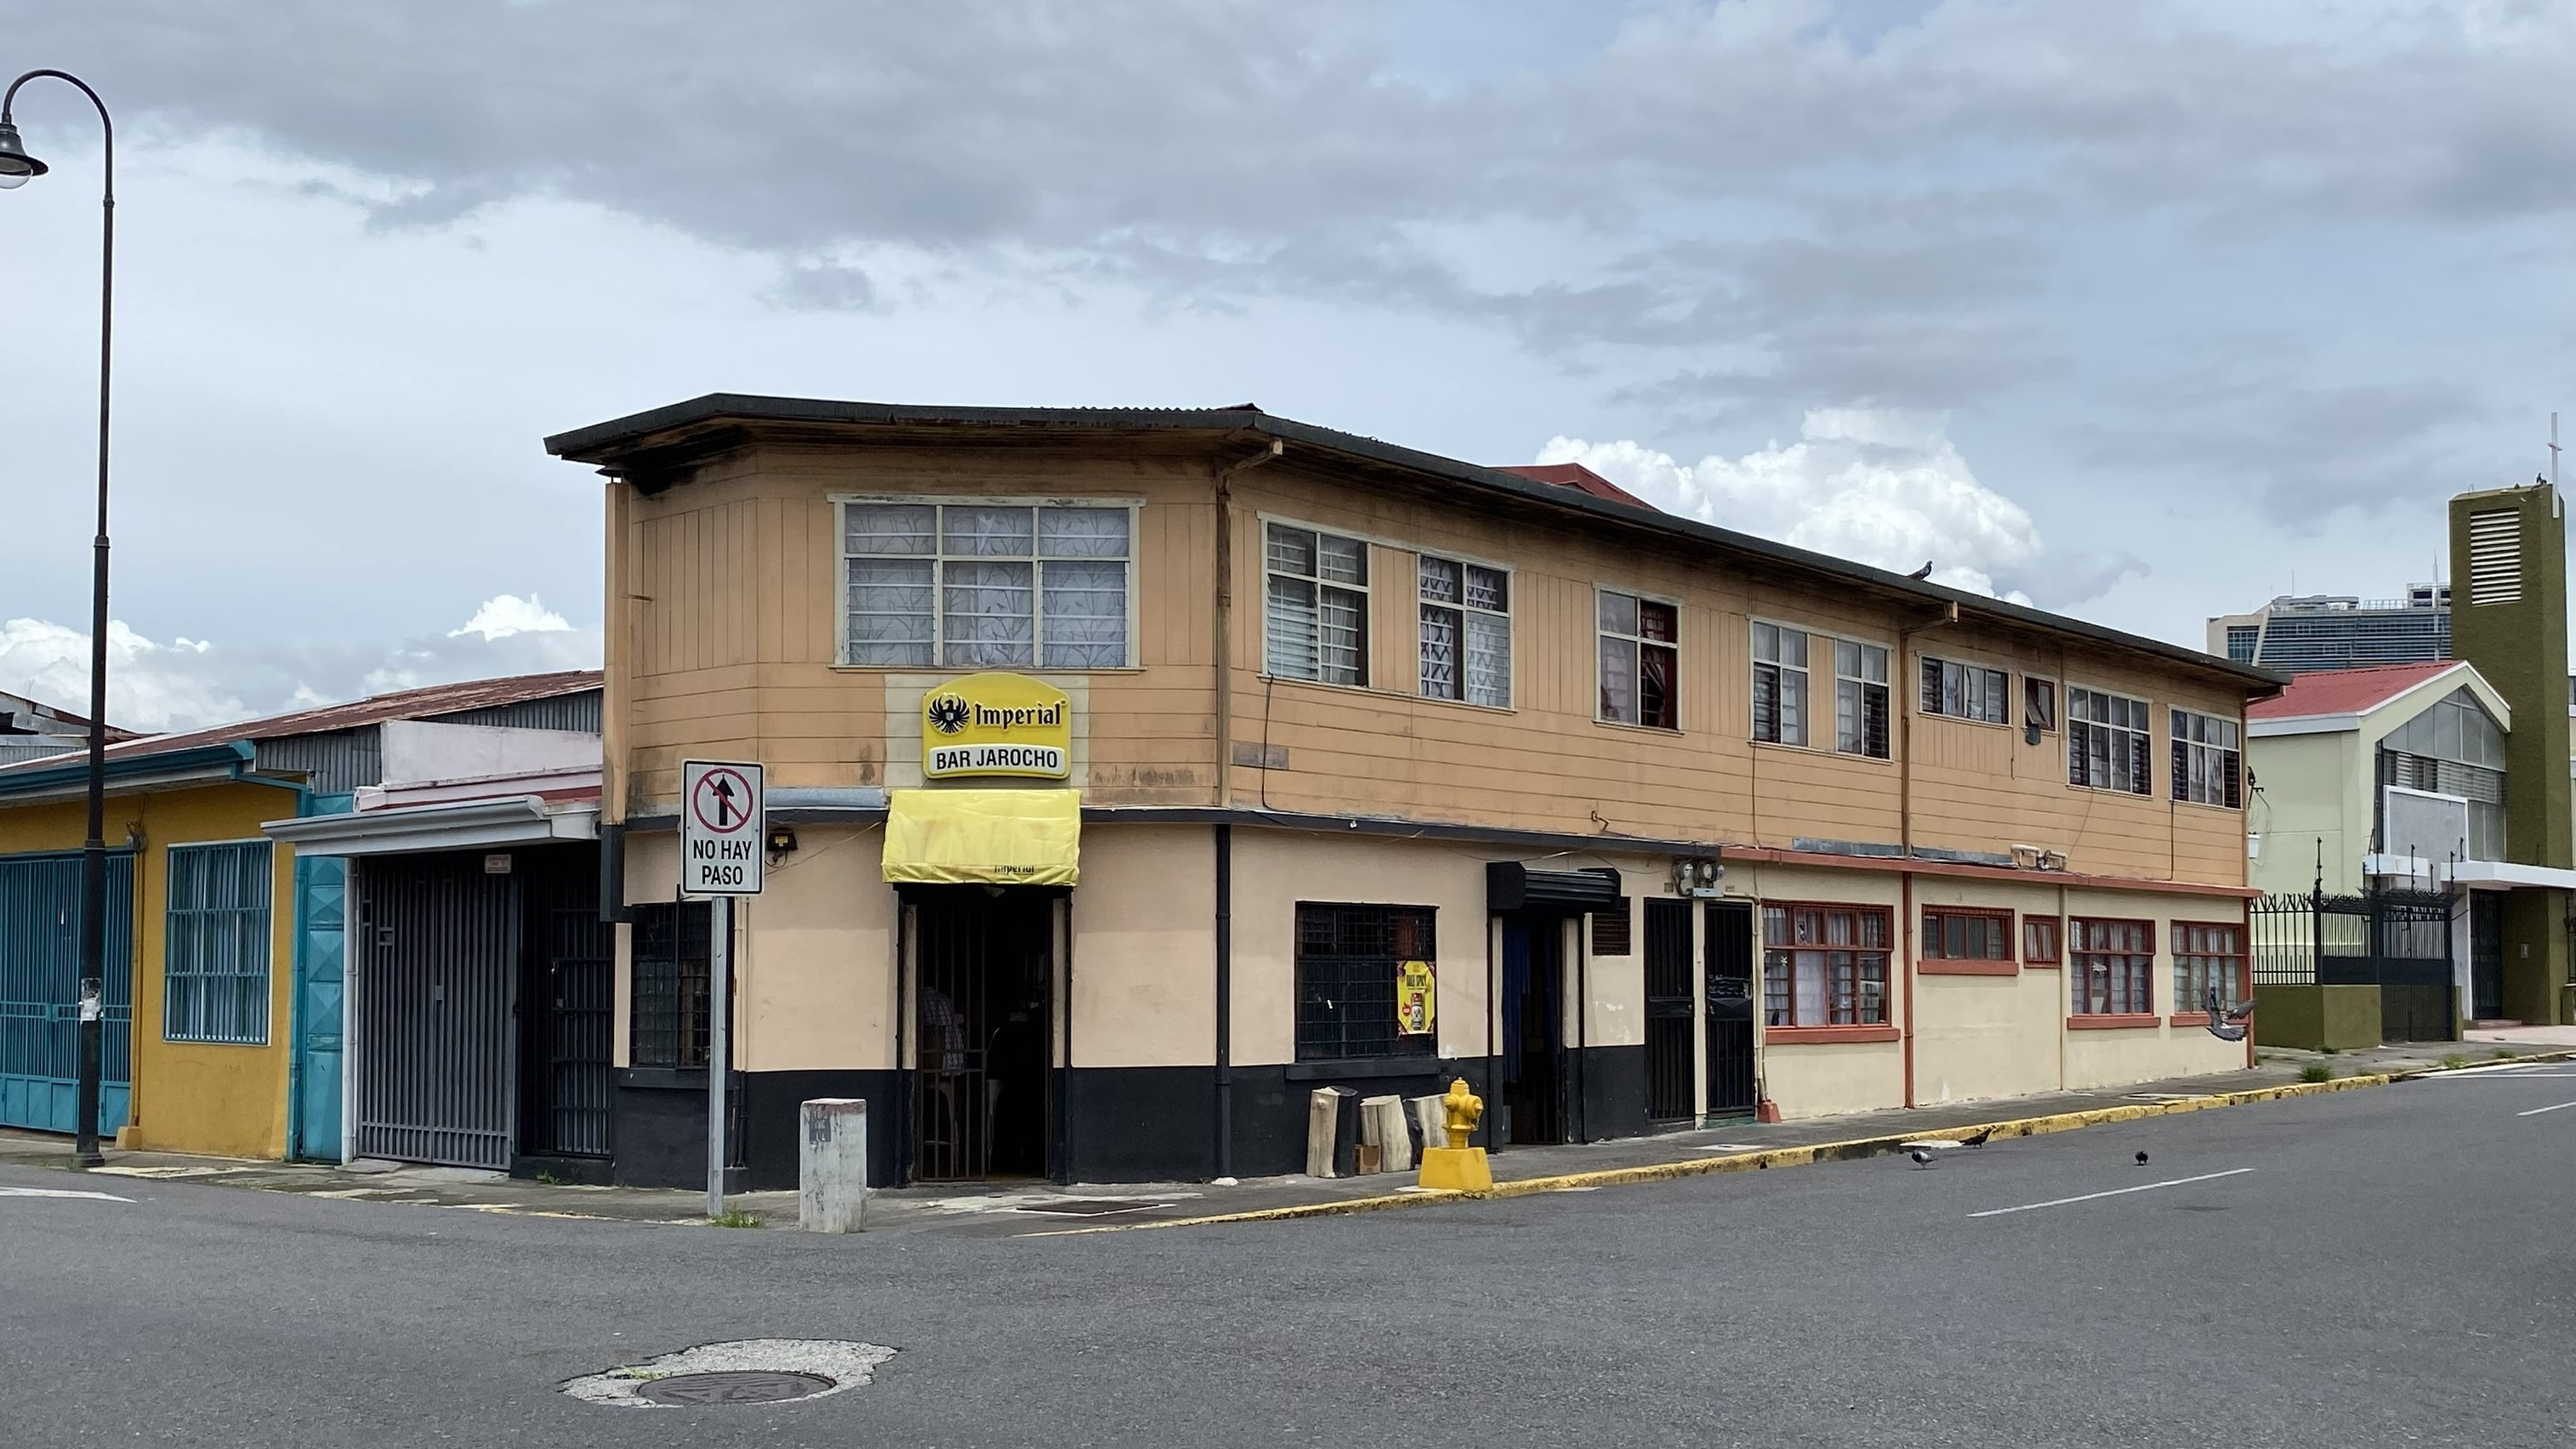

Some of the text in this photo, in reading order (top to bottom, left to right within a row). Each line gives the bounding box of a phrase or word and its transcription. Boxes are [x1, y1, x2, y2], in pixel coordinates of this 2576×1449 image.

[975, 702, 1061, 730] Imperial
[936, 748, 1058, 770] BAR JAROCHO
[693, 839, 753, 861] NO HAY
[702, 865, 743, 885] PASO
